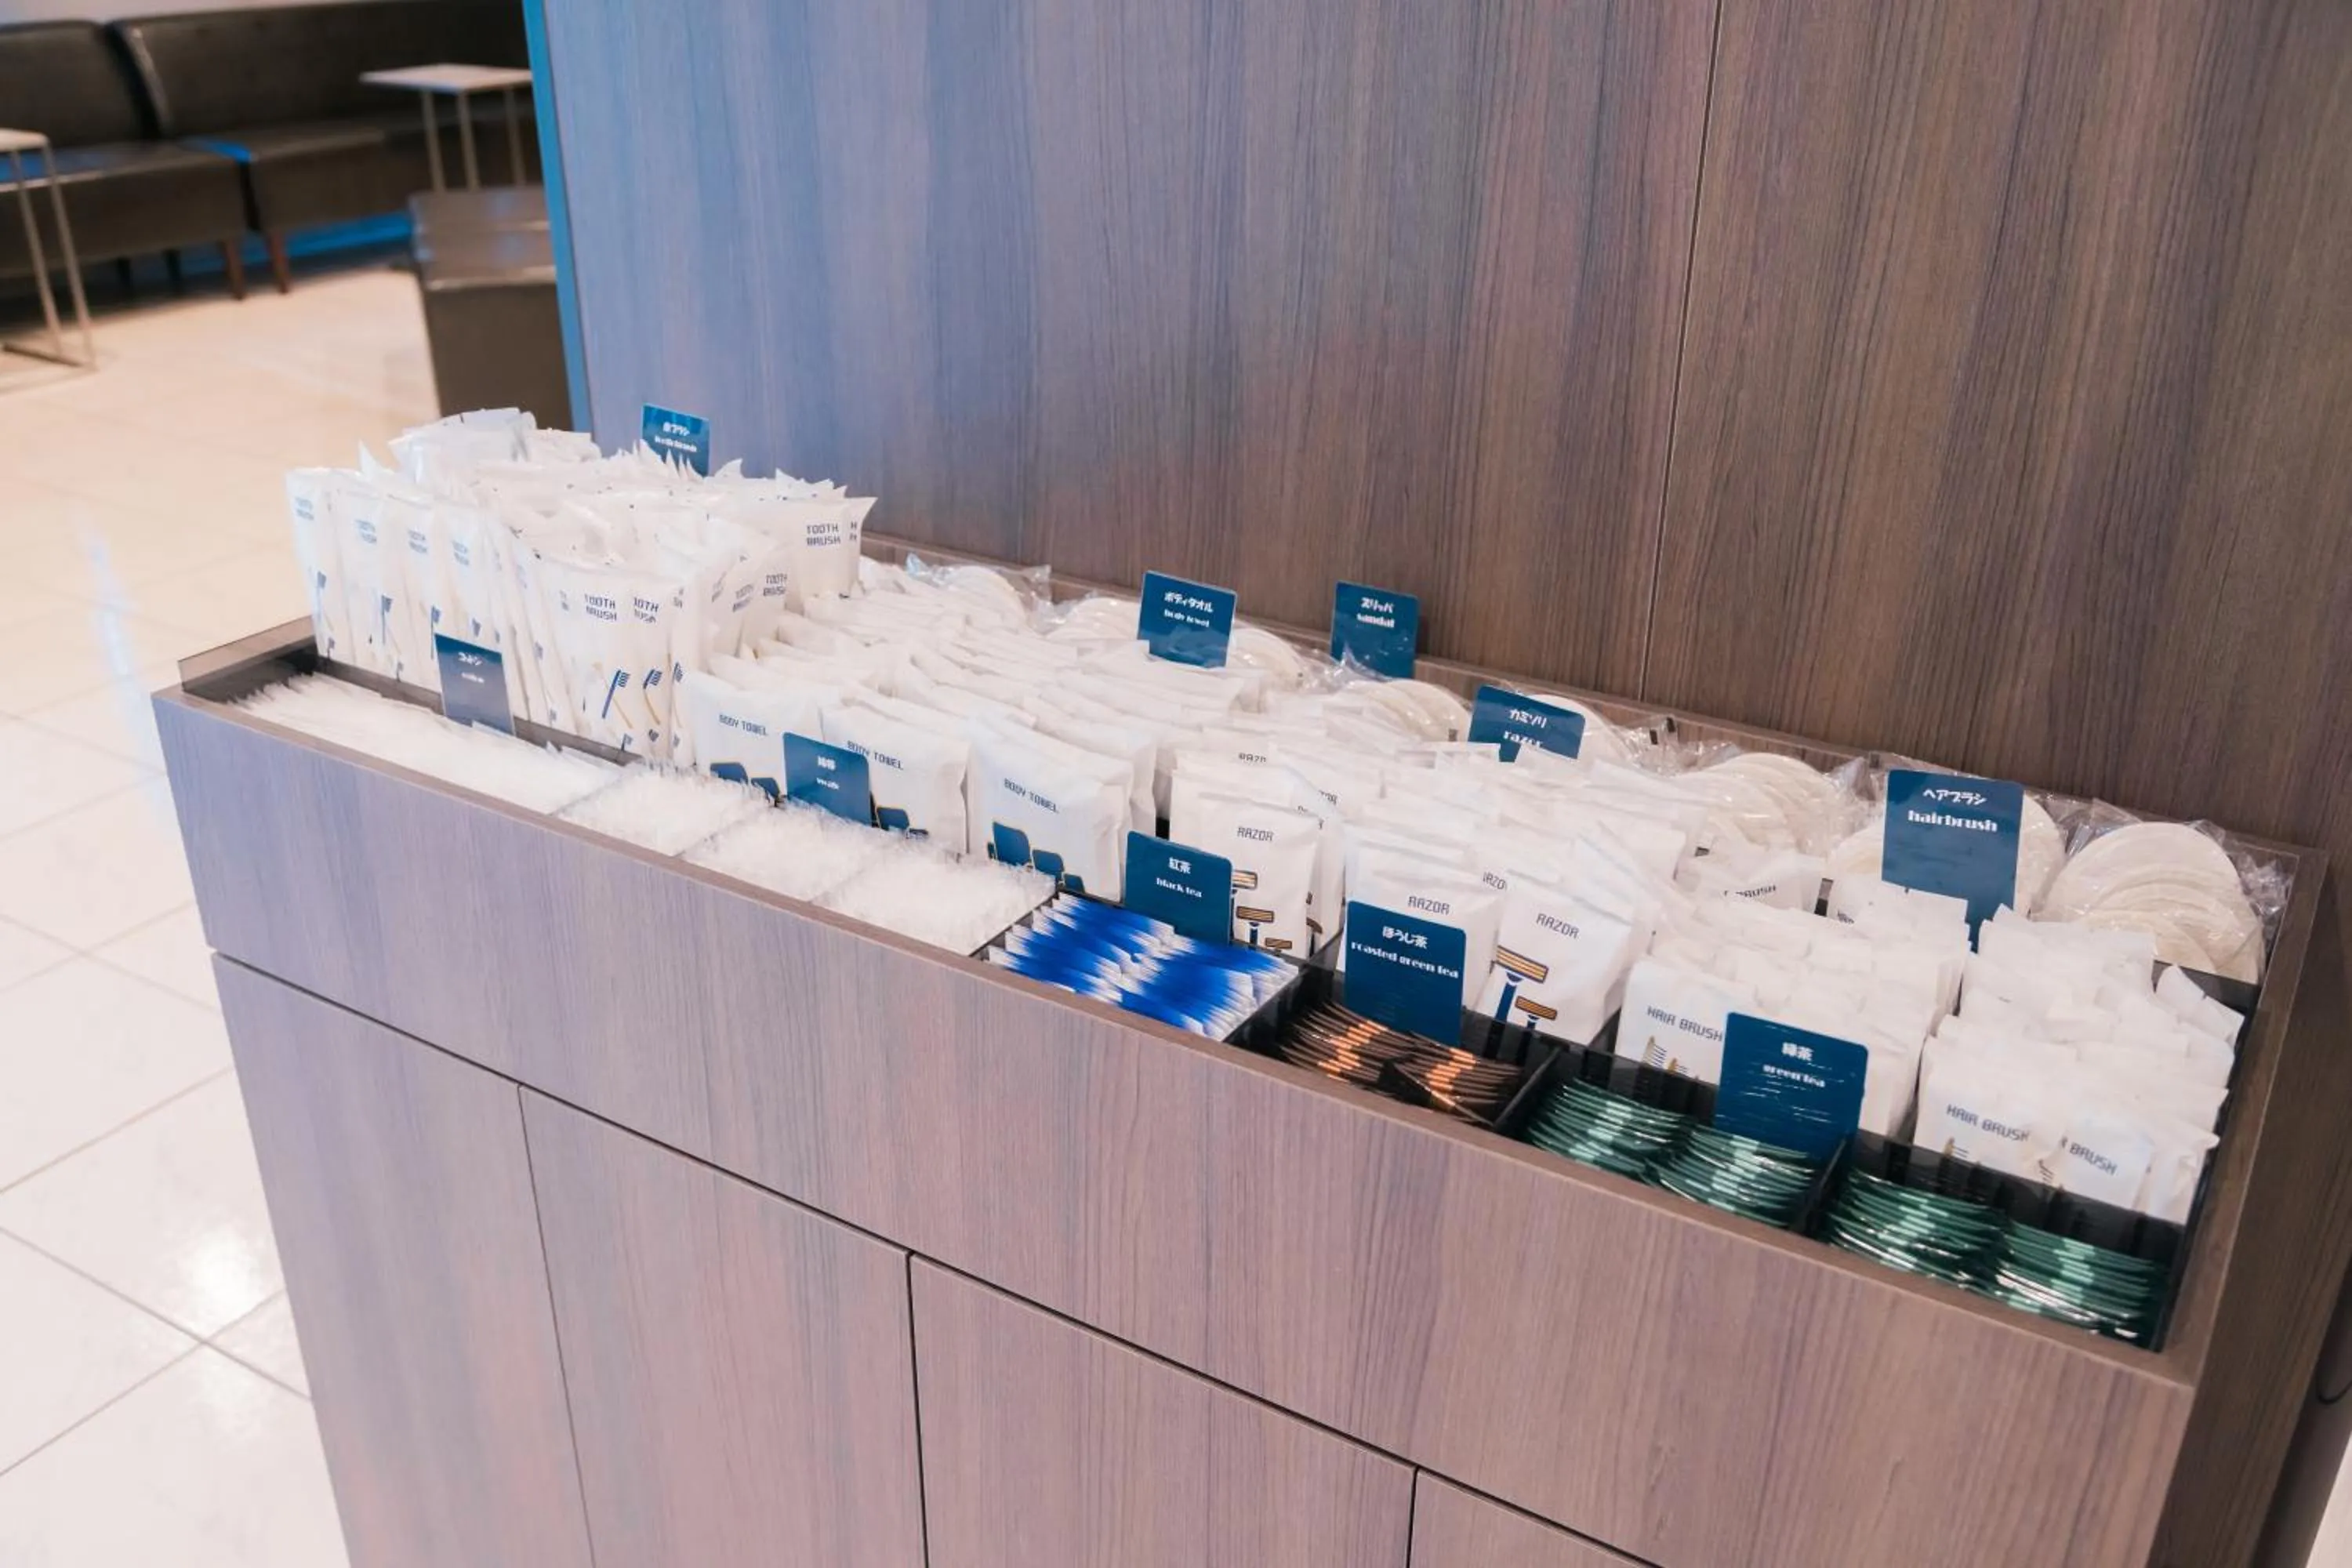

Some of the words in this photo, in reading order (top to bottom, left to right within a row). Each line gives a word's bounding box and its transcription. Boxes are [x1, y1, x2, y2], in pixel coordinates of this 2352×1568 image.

[1509, 708, 1548, 728] カミソリ
[1923, 788, 1987, 806] ヘアブラシ
[1907, 809, 1998, 833] hairbrush
[1237, 826, 1275, 842] RAZOR
[1156, 877, 1185, 895] black
[1185, 886, 1203, 898] tea
[1407, 895, 1450, 915] RAZOR
[1382, 925, 1428, 949] ほうじ茶
[1535, 913, 1580, 939] RAZOR
[1351, 941, 1398, 963] roasted
[1399, 956, 1436, 973] green
[1436, 965, 1459, 979] tea
[1647, 1005, 1676, 1025] HAIR
[1679, 1018, 1722, 1042] BRUSH
[1762, 1064, 1802, 1082] green
[1802, 1073, 1826, 1088] tea
[1946, 1104, 1978, 1127] HAIR
[1981, 1117, 2030, 1142] BRUSH
[2069, 1142, 2118, 1176] BRUSH
